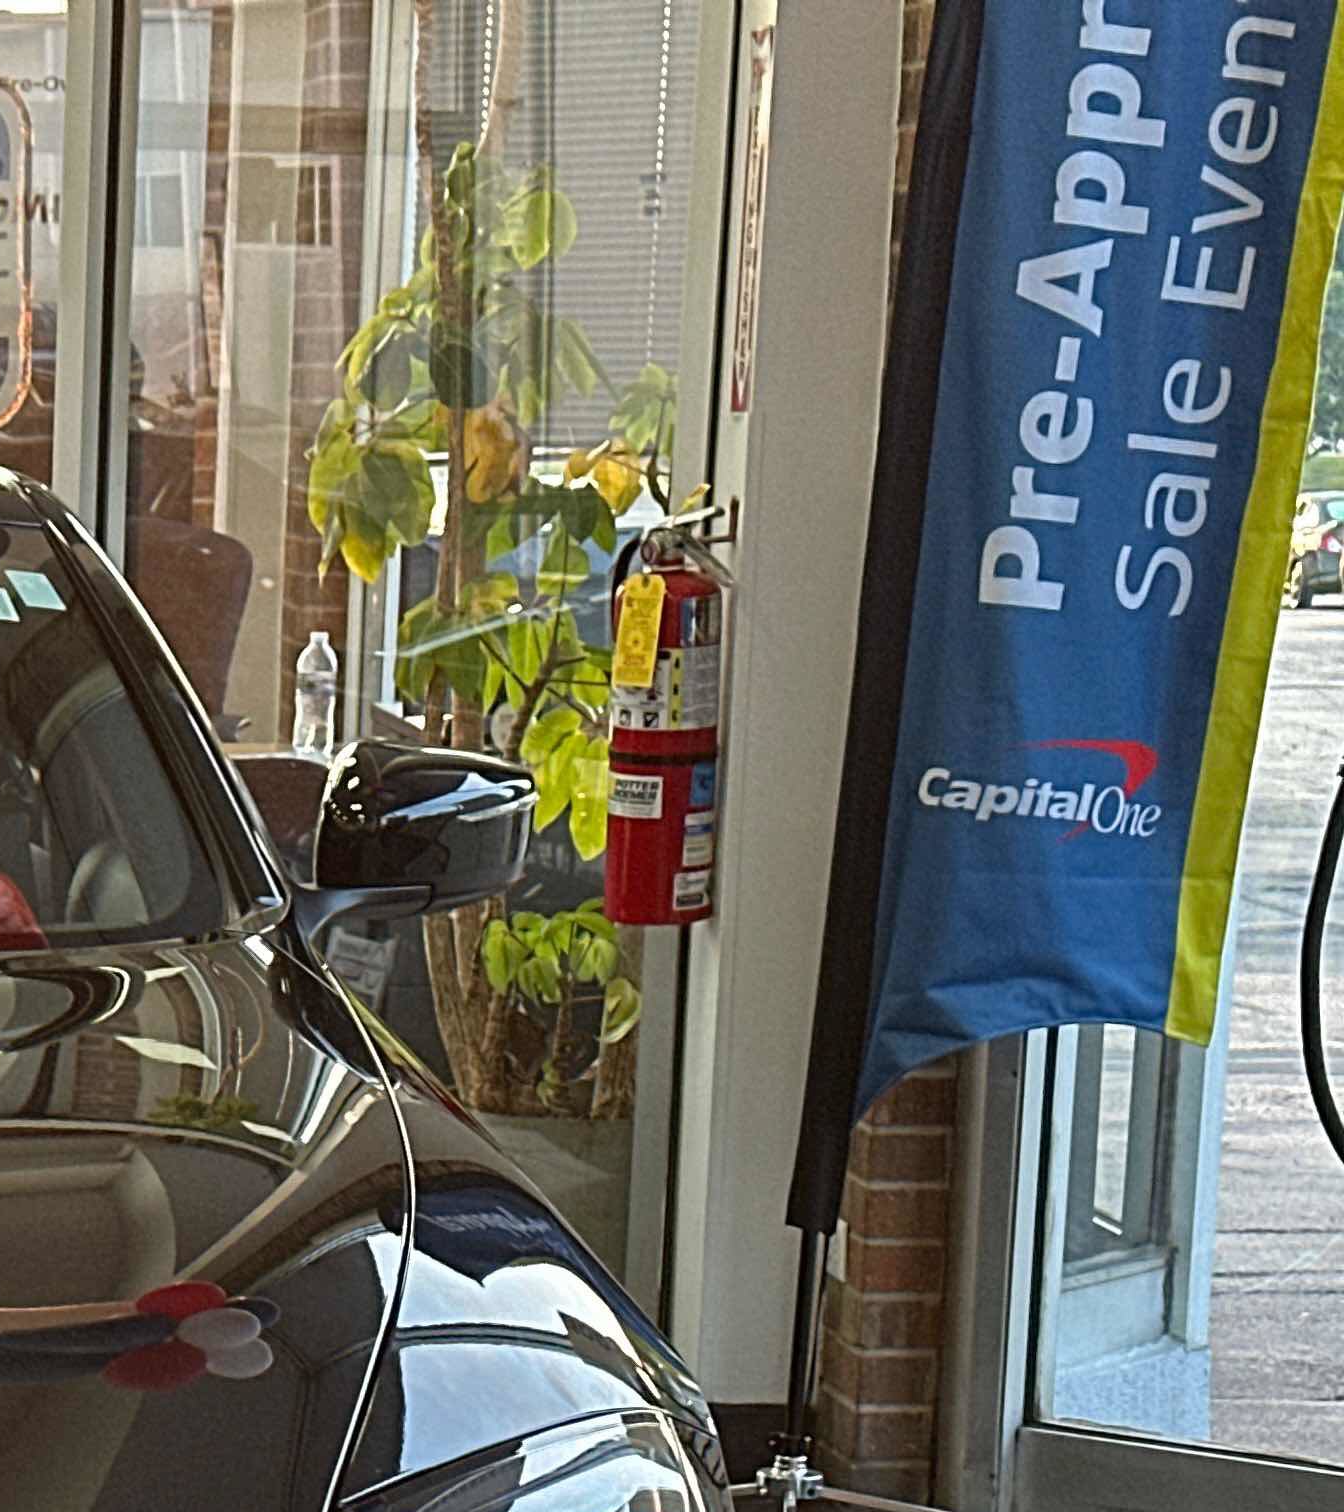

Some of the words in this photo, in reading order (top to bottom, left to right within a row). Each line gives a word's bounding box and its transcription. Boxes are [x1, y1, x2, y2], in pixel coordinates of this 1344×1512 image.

[978, 0, 1167, 611] Pre-Appr
[1161, 0, 1296, 311] Even
[1115, 358, 1232, 617] Sale
